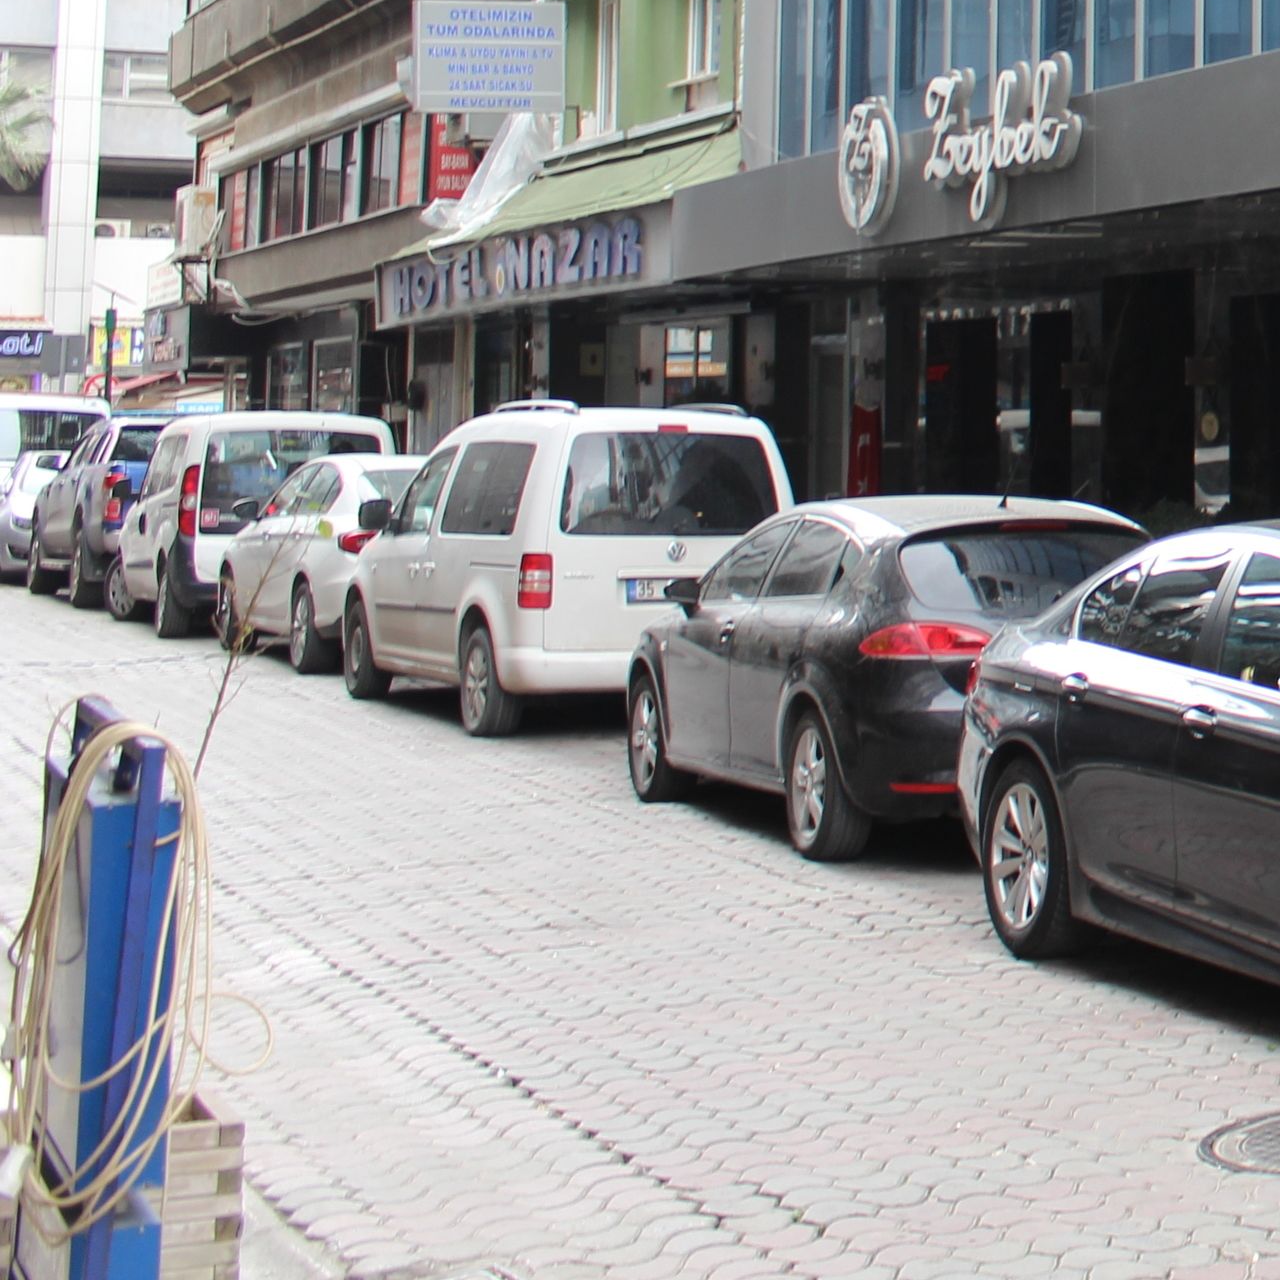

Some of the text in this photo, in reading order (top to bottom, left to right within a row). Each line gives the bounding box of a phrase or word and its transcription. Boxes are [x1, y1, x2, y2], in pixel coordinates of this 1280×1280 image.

[923, 56, 1073, 224] Zeybek
[392, 217, 642, 316] HOTEL NAZAR
